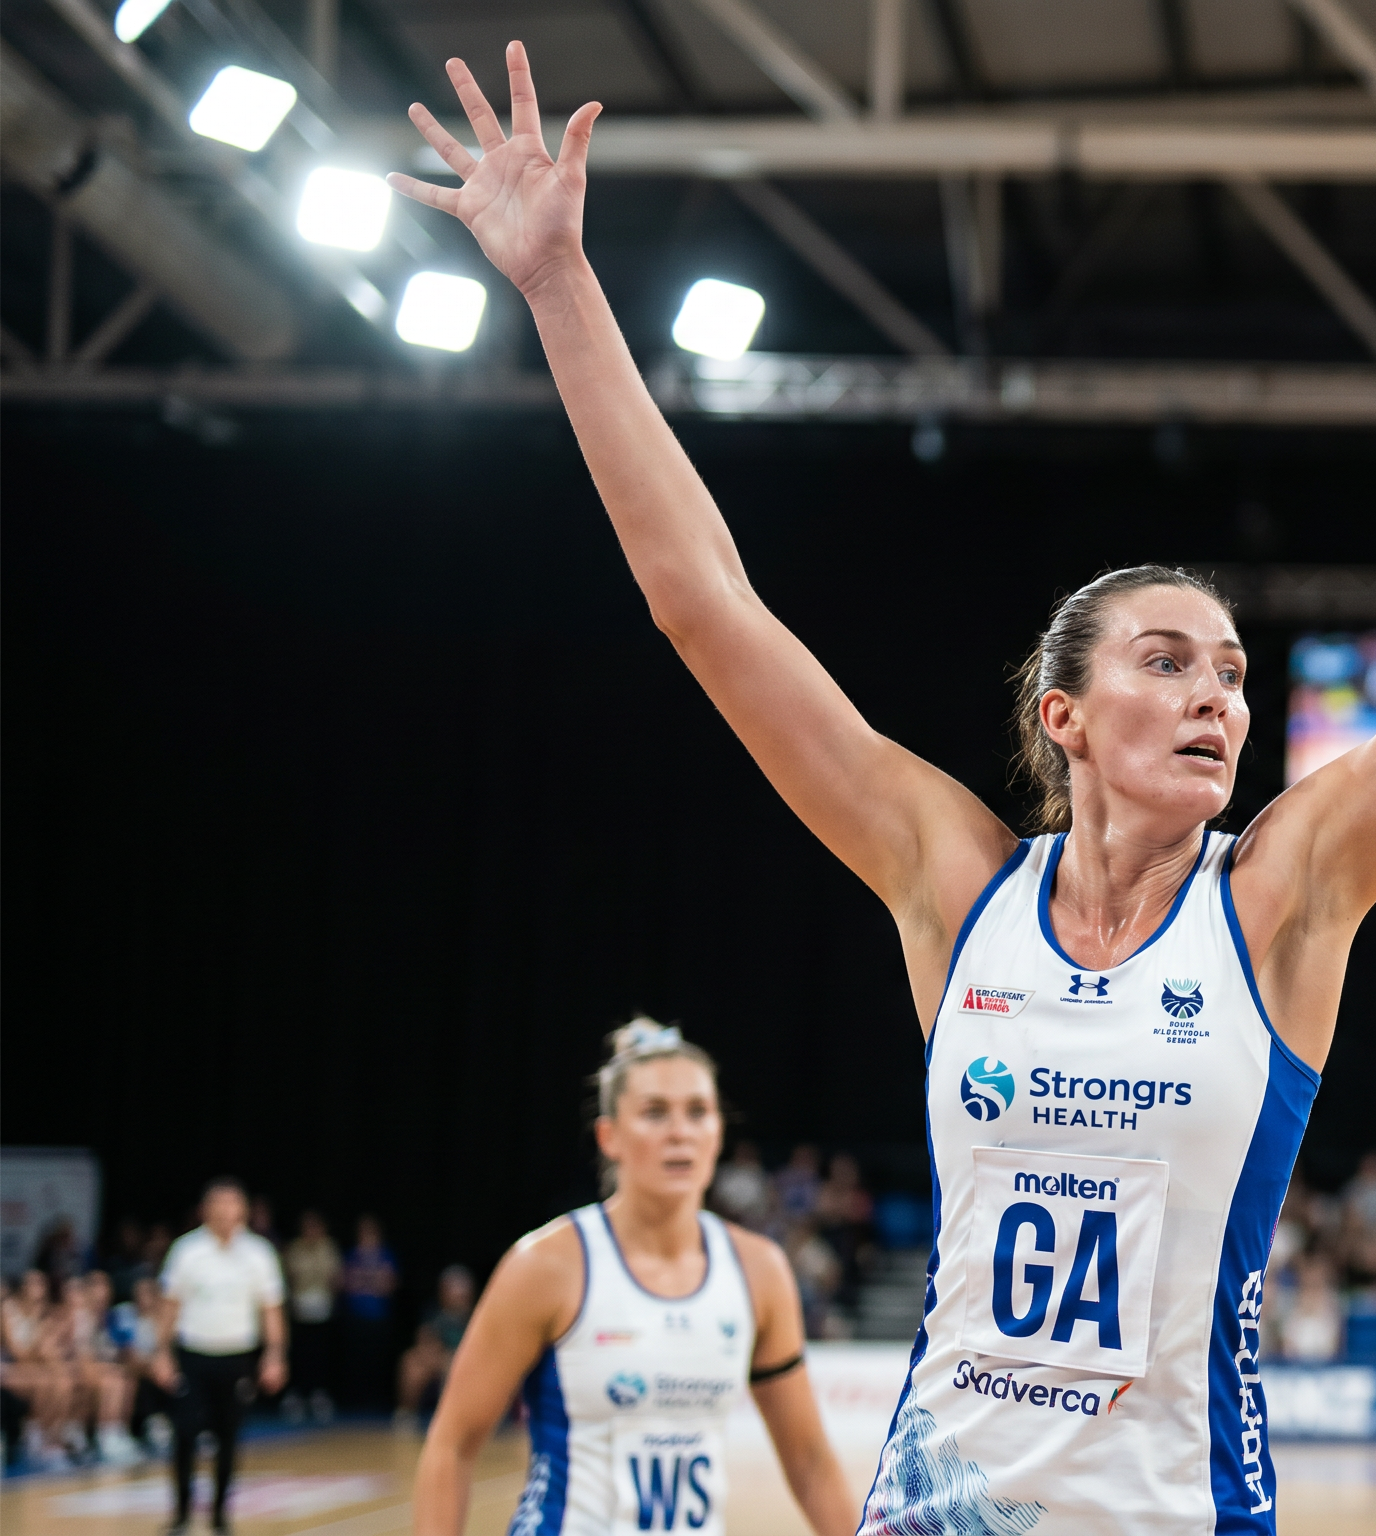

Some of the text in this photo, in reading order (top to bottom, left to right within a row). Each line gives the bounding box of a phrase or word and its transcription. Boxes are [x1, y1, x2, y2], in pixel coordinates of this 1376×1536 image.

[1029, 1067, 1192, 1110] Strongrs
[1033, 1106, 1137, 1131] HEALTH
[1014, 1172, 1117, 1201] molten
[992, 1202, 1122, 1350] GA
[628, 1454, 711, 1532] WS
